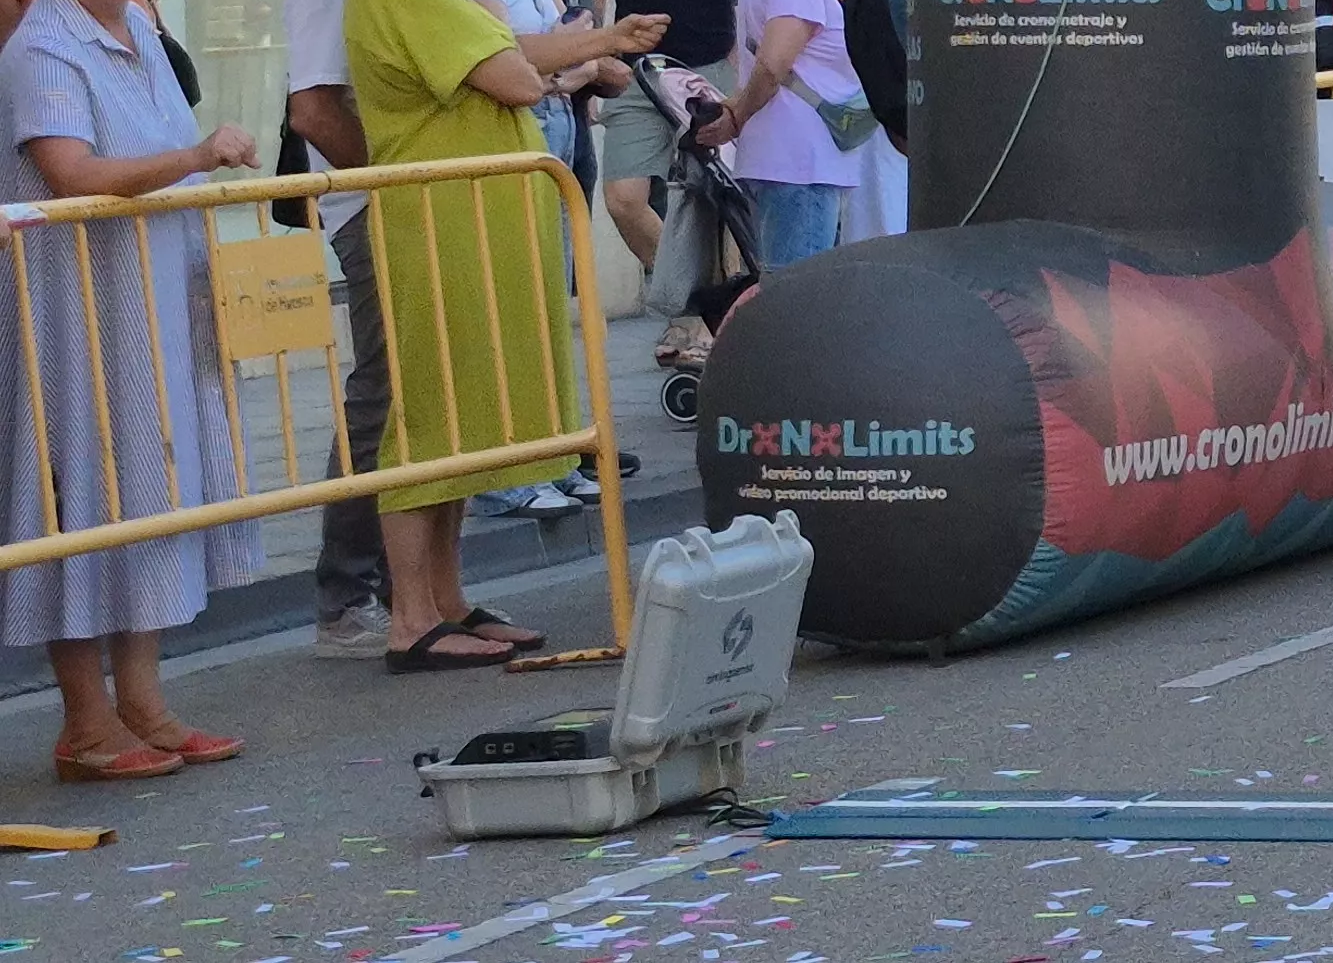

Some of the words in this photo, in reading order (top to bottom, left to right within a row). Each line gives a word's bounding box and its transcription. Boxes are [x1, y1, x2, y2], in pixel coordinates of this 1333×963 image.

[954, 13, 996, 28] Servicio
[998, 13, 1015, 27] de
[1116, 15, 1127, 30] y
[1232, 21, 1276, 36] Servicio
[991, 32, 1007, 46] de
[1065, 32, 1144, 48] deportivos
[1226, 41, 1269, 58] gestión
[761, 464, 812, 482] Servicio
[815, 466, 834, 481] de
[900, 469, 912, 484] y
[775, 485, 864, 503] promocional
[867, 485, 948, 503] deportivo
